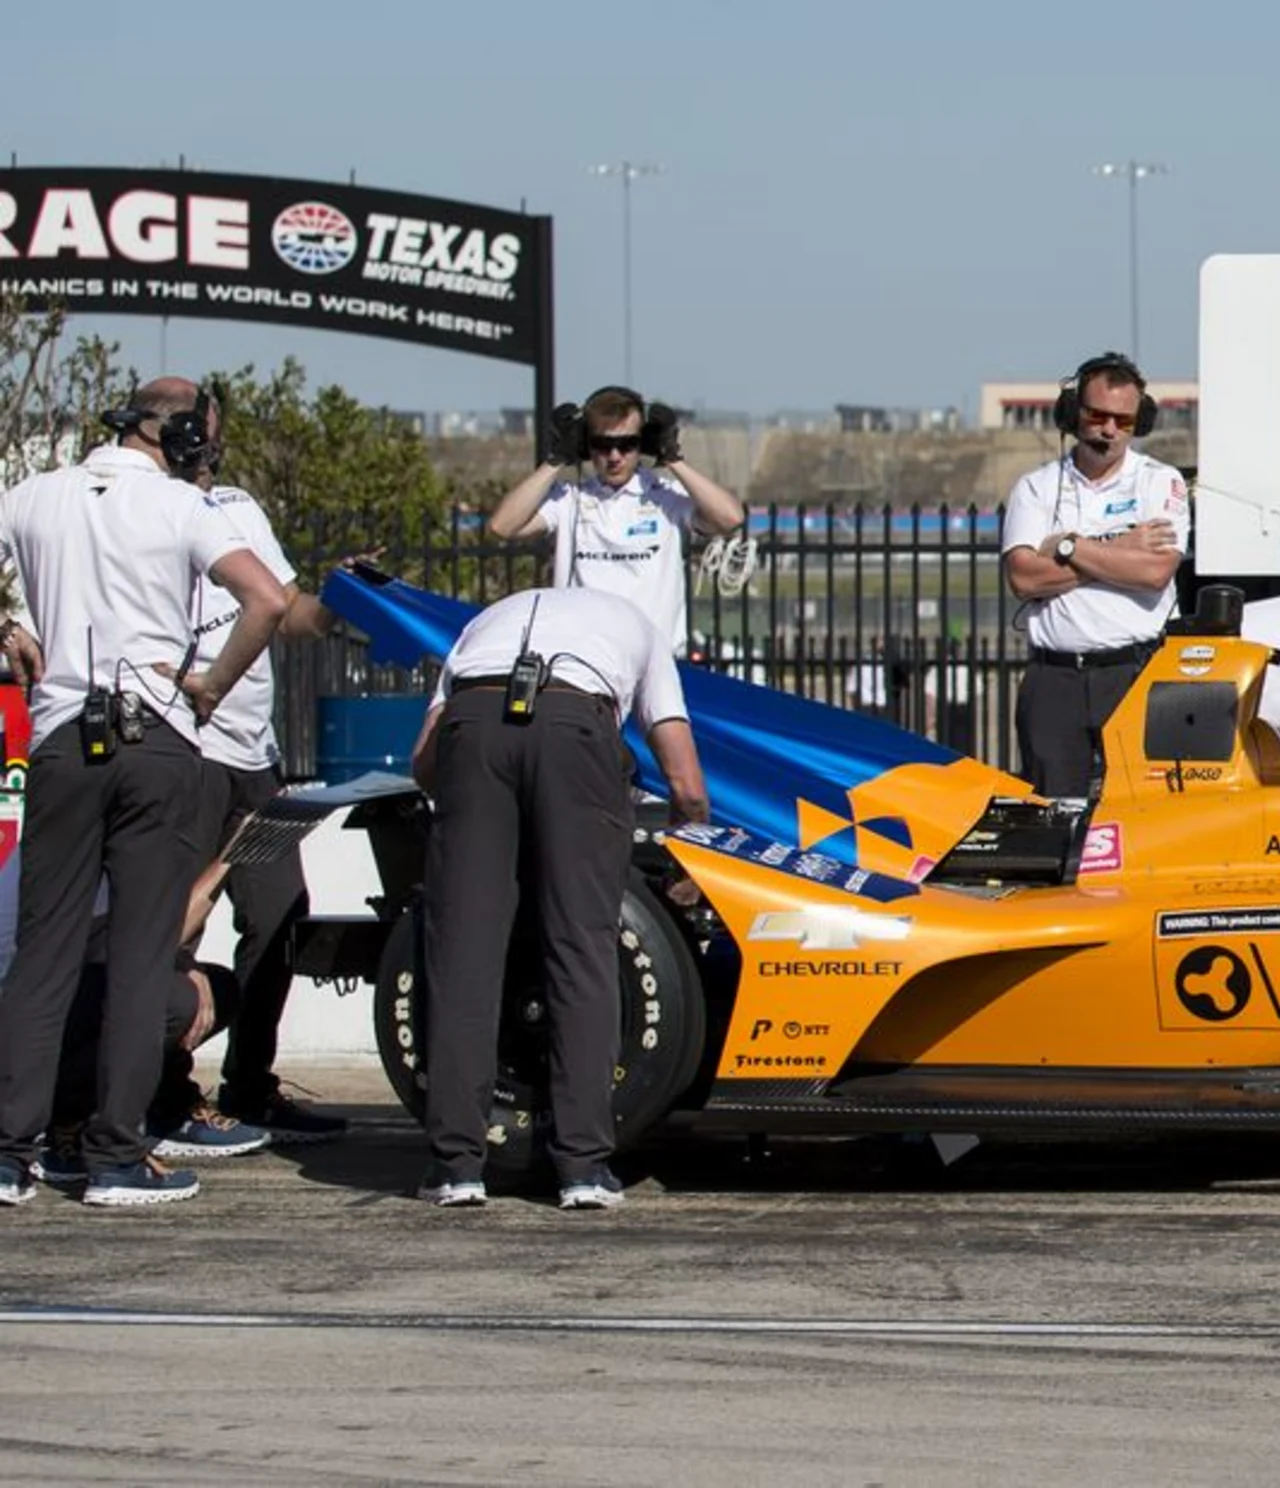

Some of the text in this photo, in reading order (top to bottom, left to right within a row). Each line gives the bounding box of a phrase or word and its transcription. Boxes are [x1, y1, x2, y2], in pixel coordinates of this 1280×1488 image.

[366, 213, 521, 281] TEXAS
[362, 261, 423, 286] MOTOR
[112, 279, 139, 297] IN
[146, 281, 199, 300] THE
[206, 283, 312, 309] WORLD
[319, 294, 409, 322] WORK
[193, 607, 244, 638] McLar
[759, 961, 903, 977] CHEVROLET
[736, 1054, 827, 1069] Firestone
